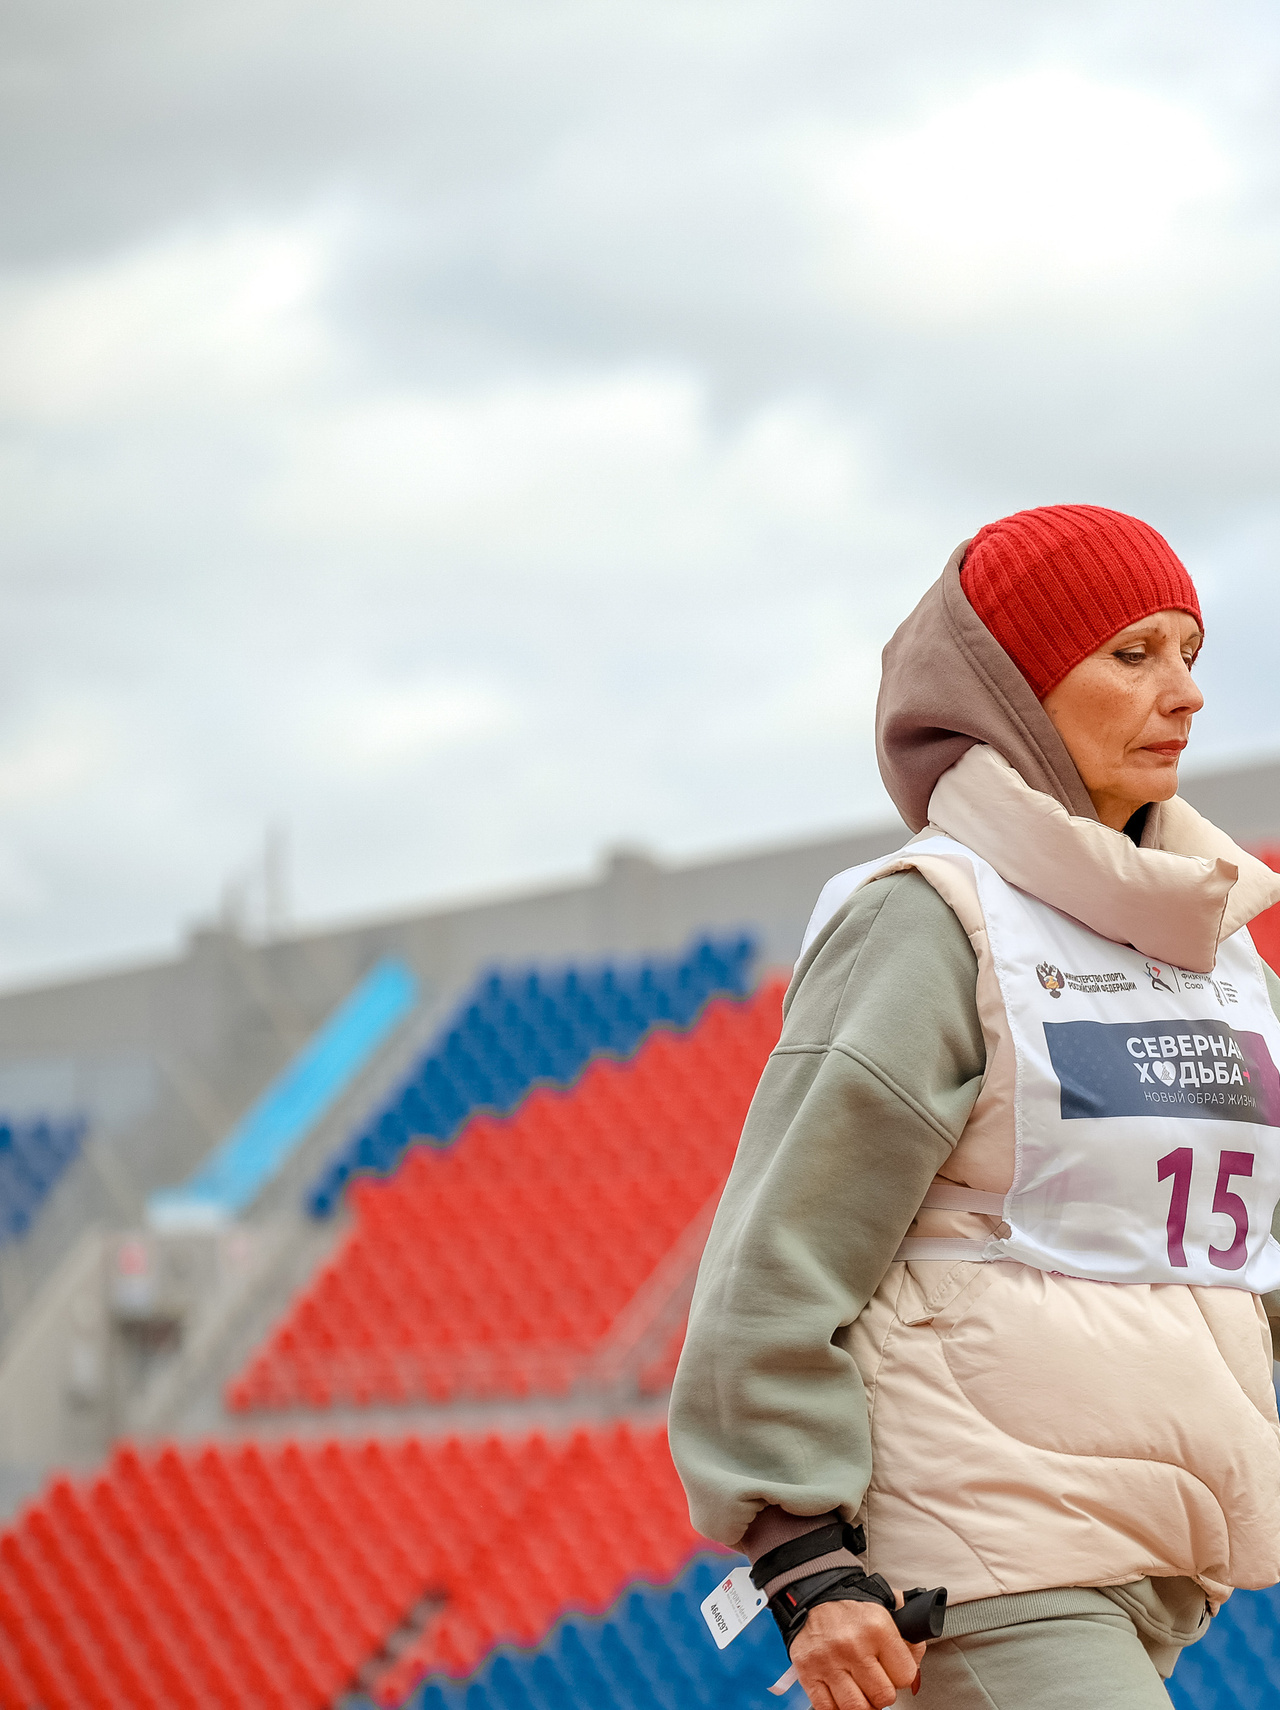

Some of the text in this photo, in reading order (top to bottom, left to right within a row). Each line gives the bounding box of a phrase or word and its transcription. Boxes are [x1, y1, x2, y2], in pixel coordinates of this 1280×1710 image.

[1102, 972, 1127, 982] СПОРТА
[1101, 982, 1138, 993] ФЕДЕРАЦИИ
[1144, 1090, 1257, 1108] НОВЫЙ ОБРАЗ ЖИЗНИ
[1157, 1147, 1254, 1270] 15
[710, 1603, 729, 1634] 4649297
